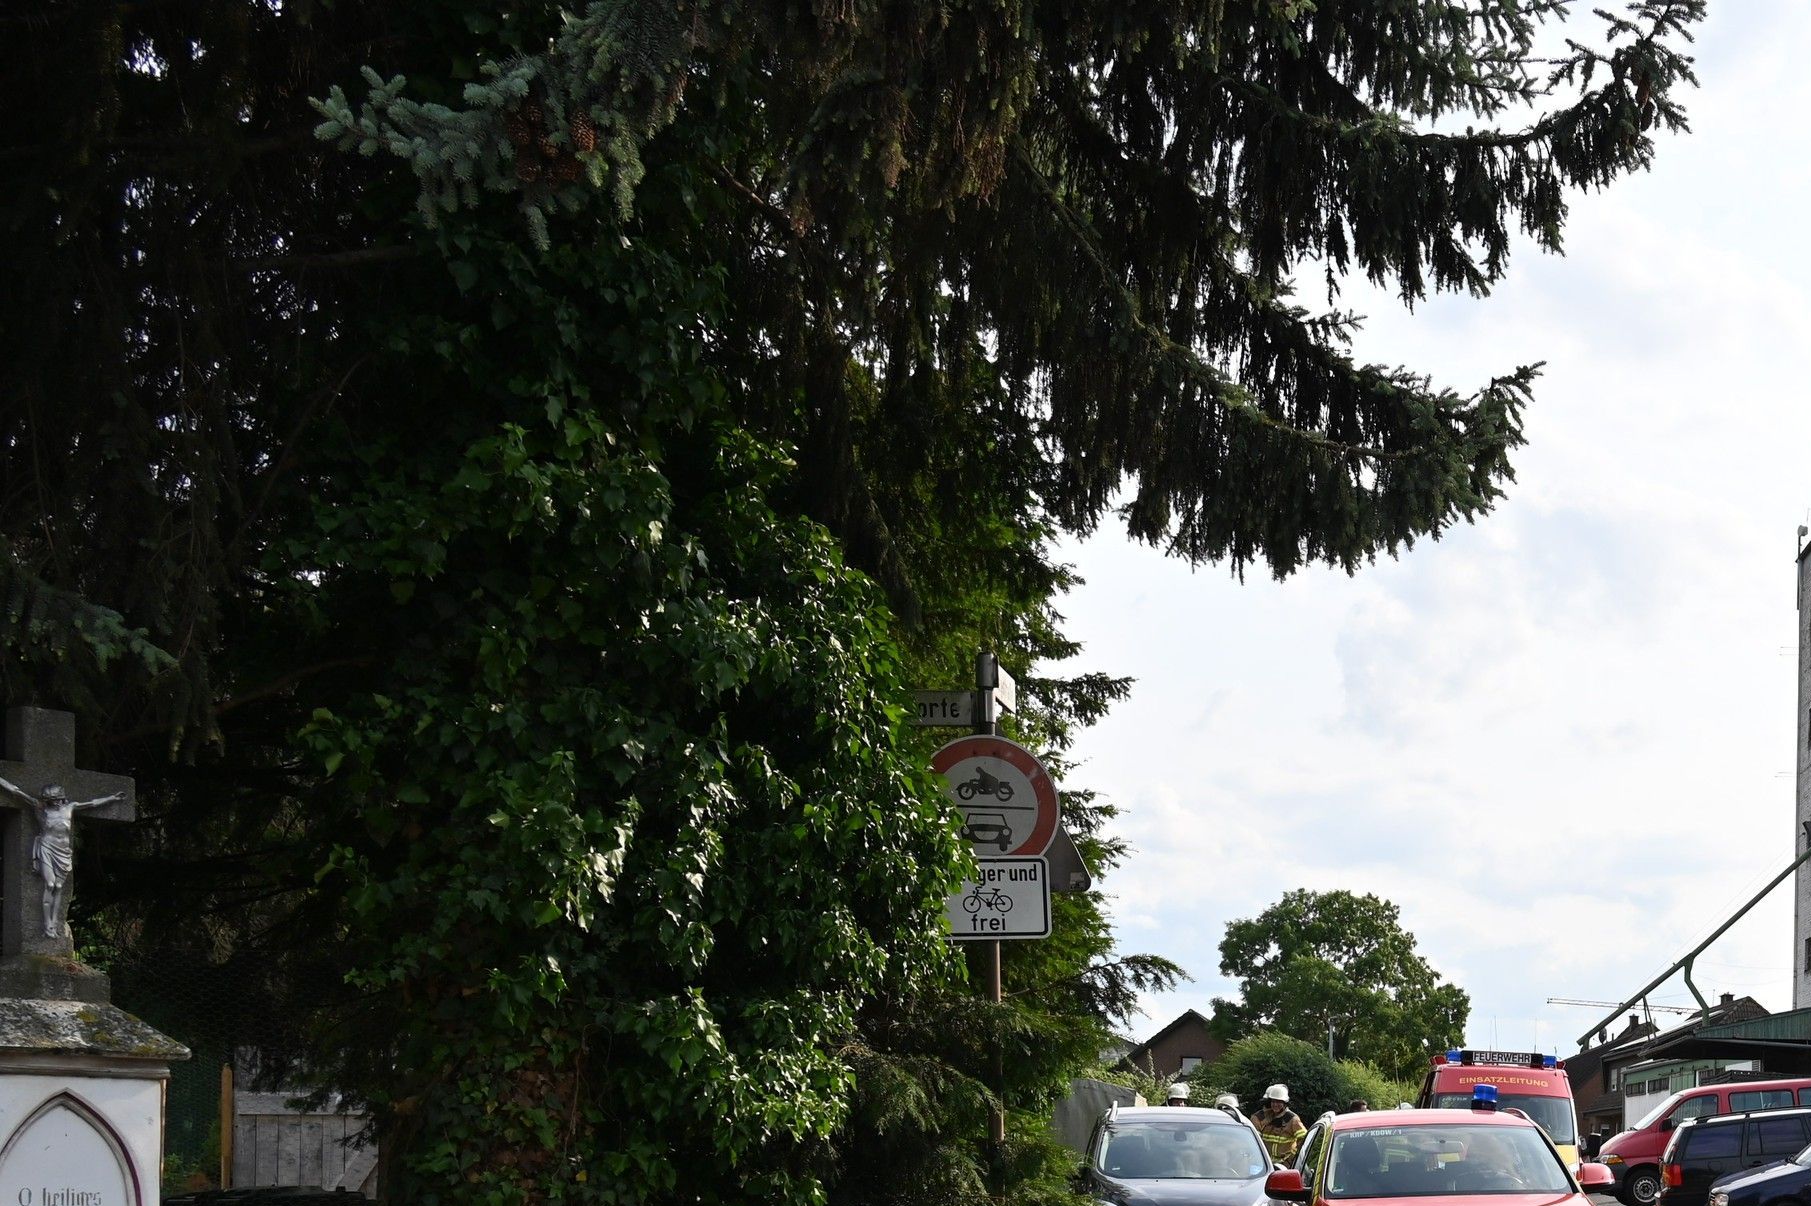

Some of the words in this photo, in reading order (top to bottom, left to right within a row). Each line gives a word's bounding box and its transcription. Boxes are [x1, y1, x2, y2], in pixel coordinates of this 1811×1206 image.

[918, 697, 961, 719] orte
[1008, 863, 1038, 882] und
[971, 913, 1007, 932] frei
[1472, 1050, 1532, 1064] FEUERWEHR
[1458, 1075, 1550, 1088] EINSATZLEITUNG
